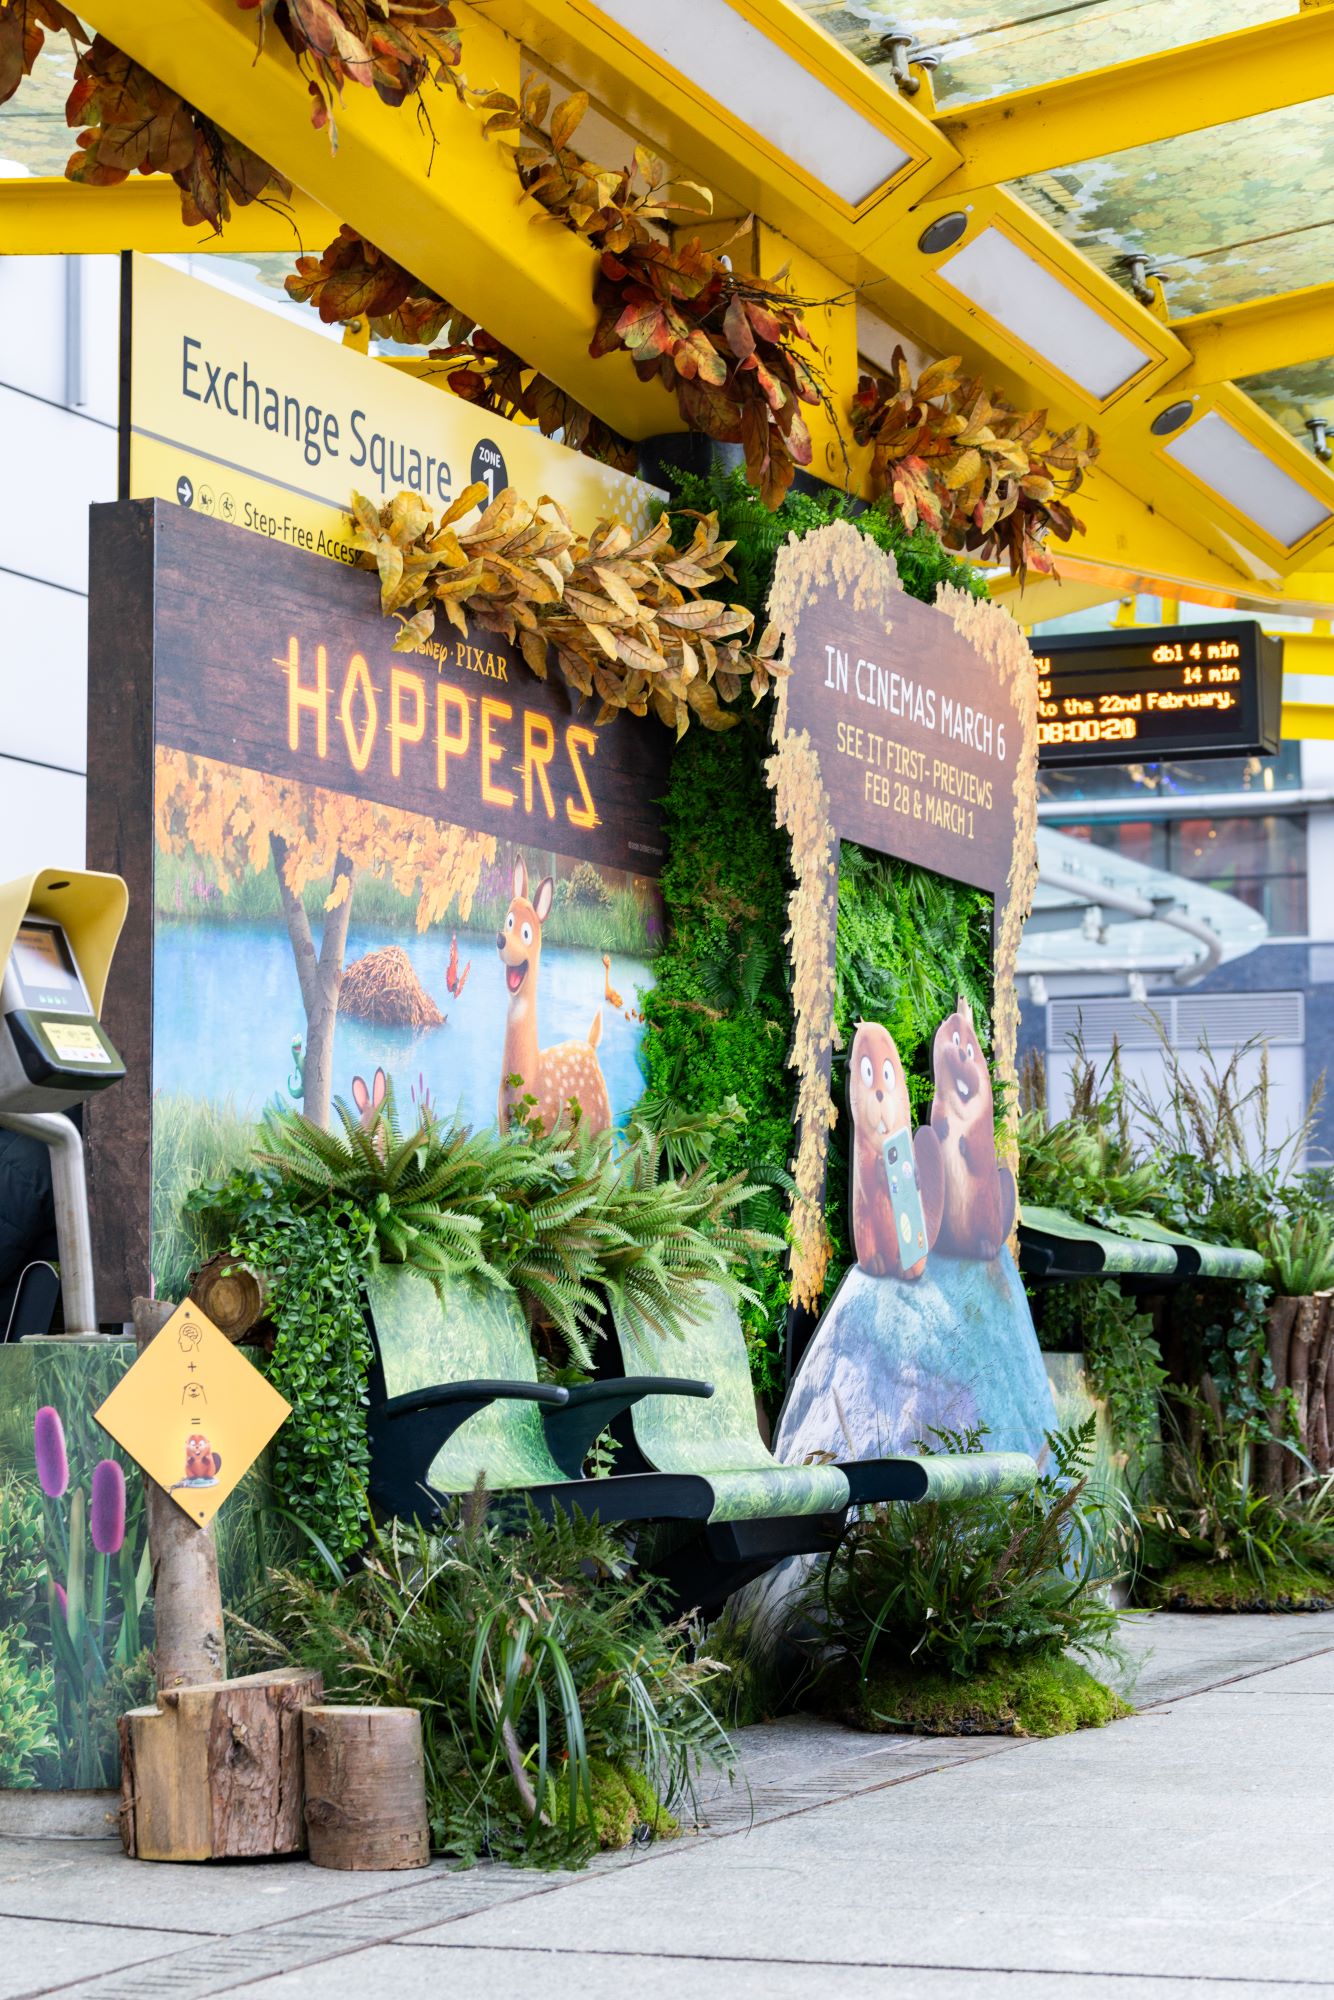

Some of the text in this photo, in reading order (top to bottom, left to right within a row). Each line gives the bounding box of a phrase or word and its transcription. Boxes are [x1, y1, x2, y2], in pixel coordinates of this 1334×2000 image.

[183, 335, 452, 503] Exchange Square
[479, 446, 501, 468] ZONE
[483, 468, 494, 506] 1
[244, 502, 313, 549] Step-Free
[456, 642, 508, 682] PIXAR
[1152, 643, 1184, 663] dbl
[1189, 642, 1202, 660] 4
[1207, 641, 1239, 659] min
[1183, 666, 1202, 684] 14
[1208, 664, 1240, 682] min
[824, 645, 1006, 761] IN CINEMAS MARCH 6
[1039, 691, 1236, 717] to the 22nd February.
[283, 635, 602, 829] HOPPERS
[836, 722, 864, 760] SEE
[867, 733, 884, 766] IT
[933, 759, 993, 810] PREVIEWS
[864, 771, 975, 840] FEB 28 & MARCH 1
